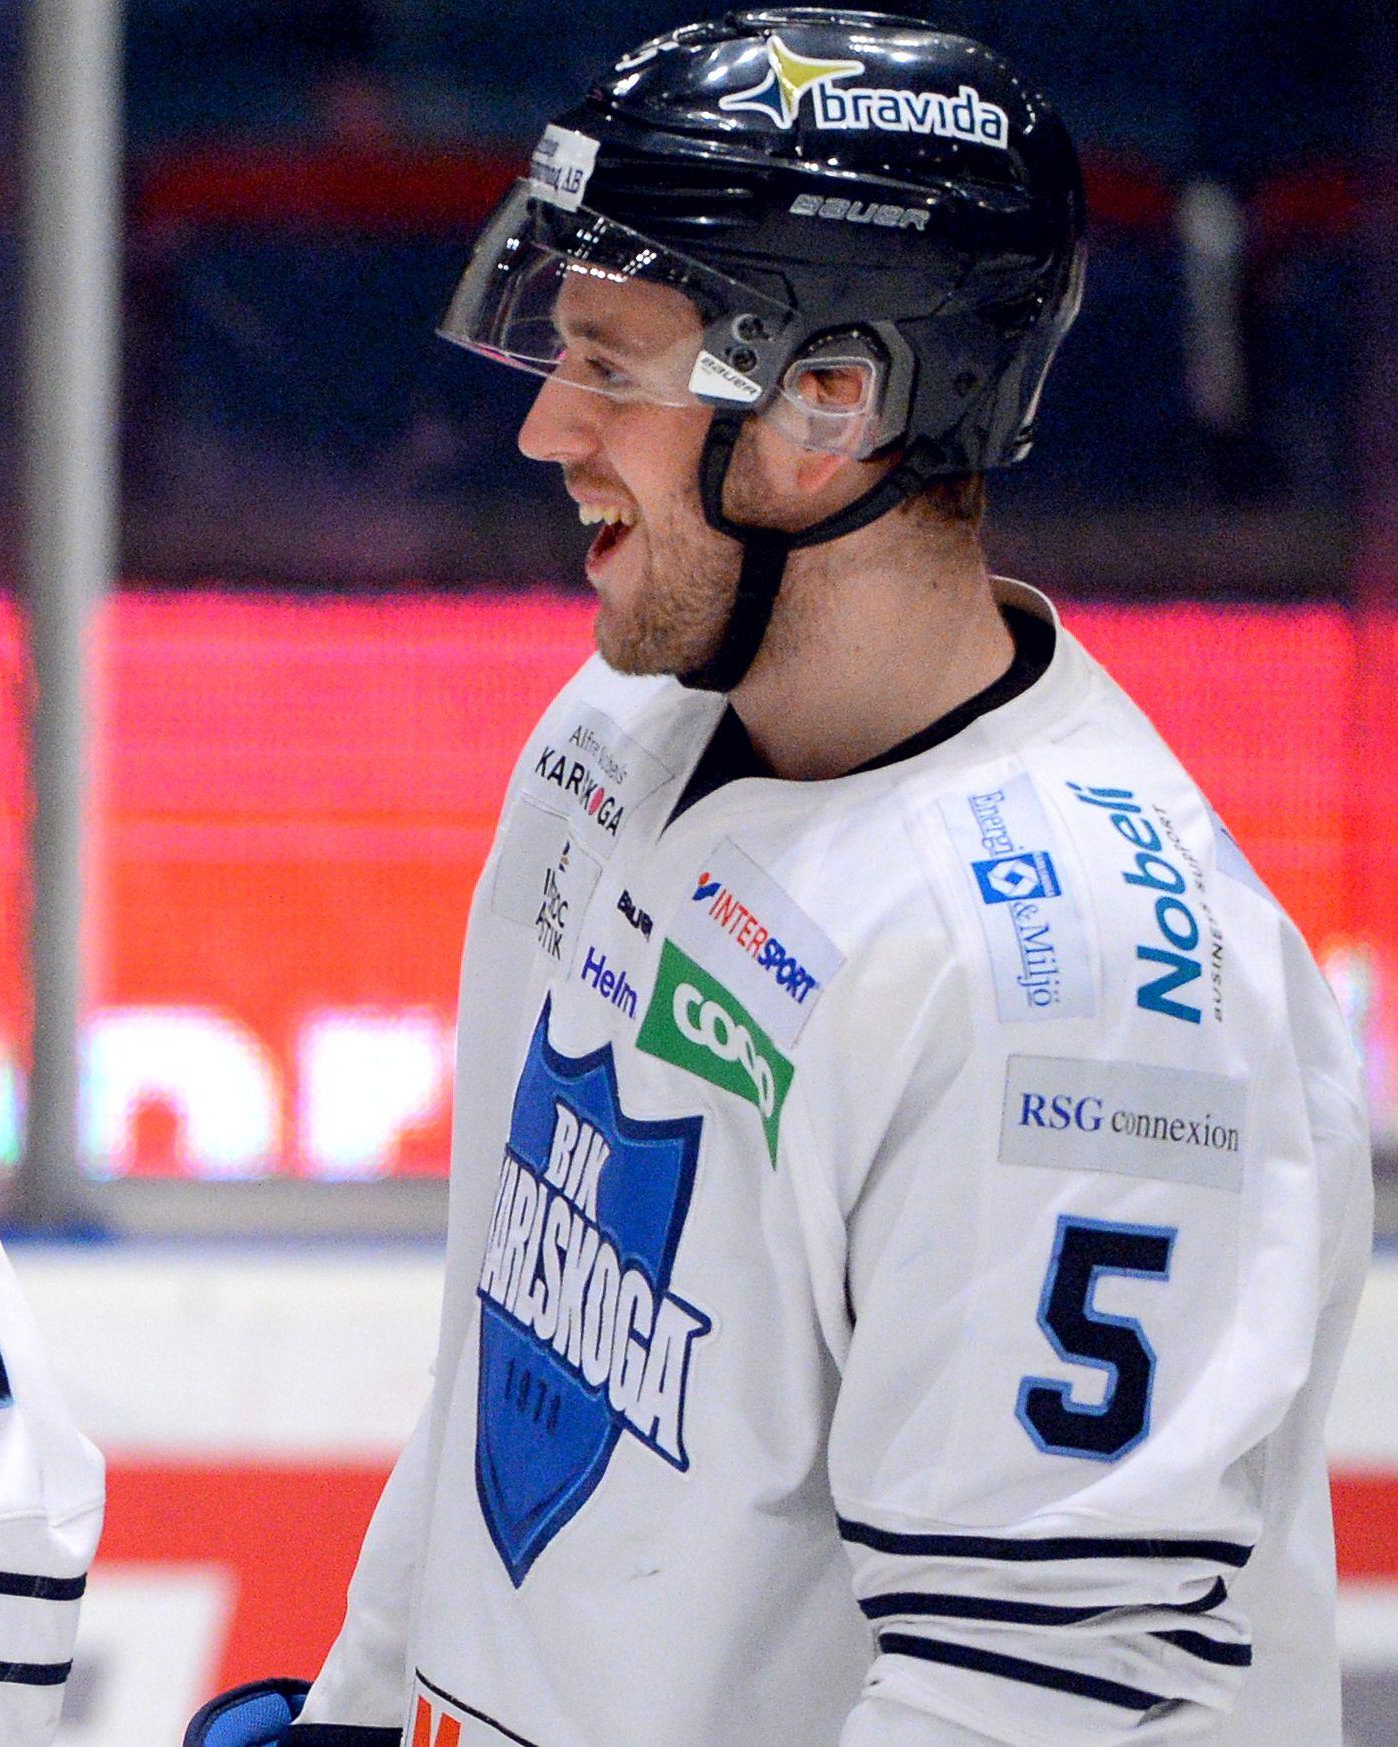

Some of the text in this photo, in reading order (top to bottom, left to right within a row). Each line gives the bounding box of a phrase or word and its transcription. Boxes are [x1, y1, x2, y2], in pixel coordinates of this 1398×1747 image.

[814, 81, 1008, 148] bravida
[972, 791, 1026, 858] Energi
[708, 887, 818, 1004] INTERSPORT
[1066, 781, 1202, 1024] Nobeli
[544, 1103, 611, 1224] BIK
[1019, 1092, 1240, 1153] RSG connexion
[478, 1153, 704, 1463] ARLSKOGA
[1014, 1213, 1179, 1464] 5
